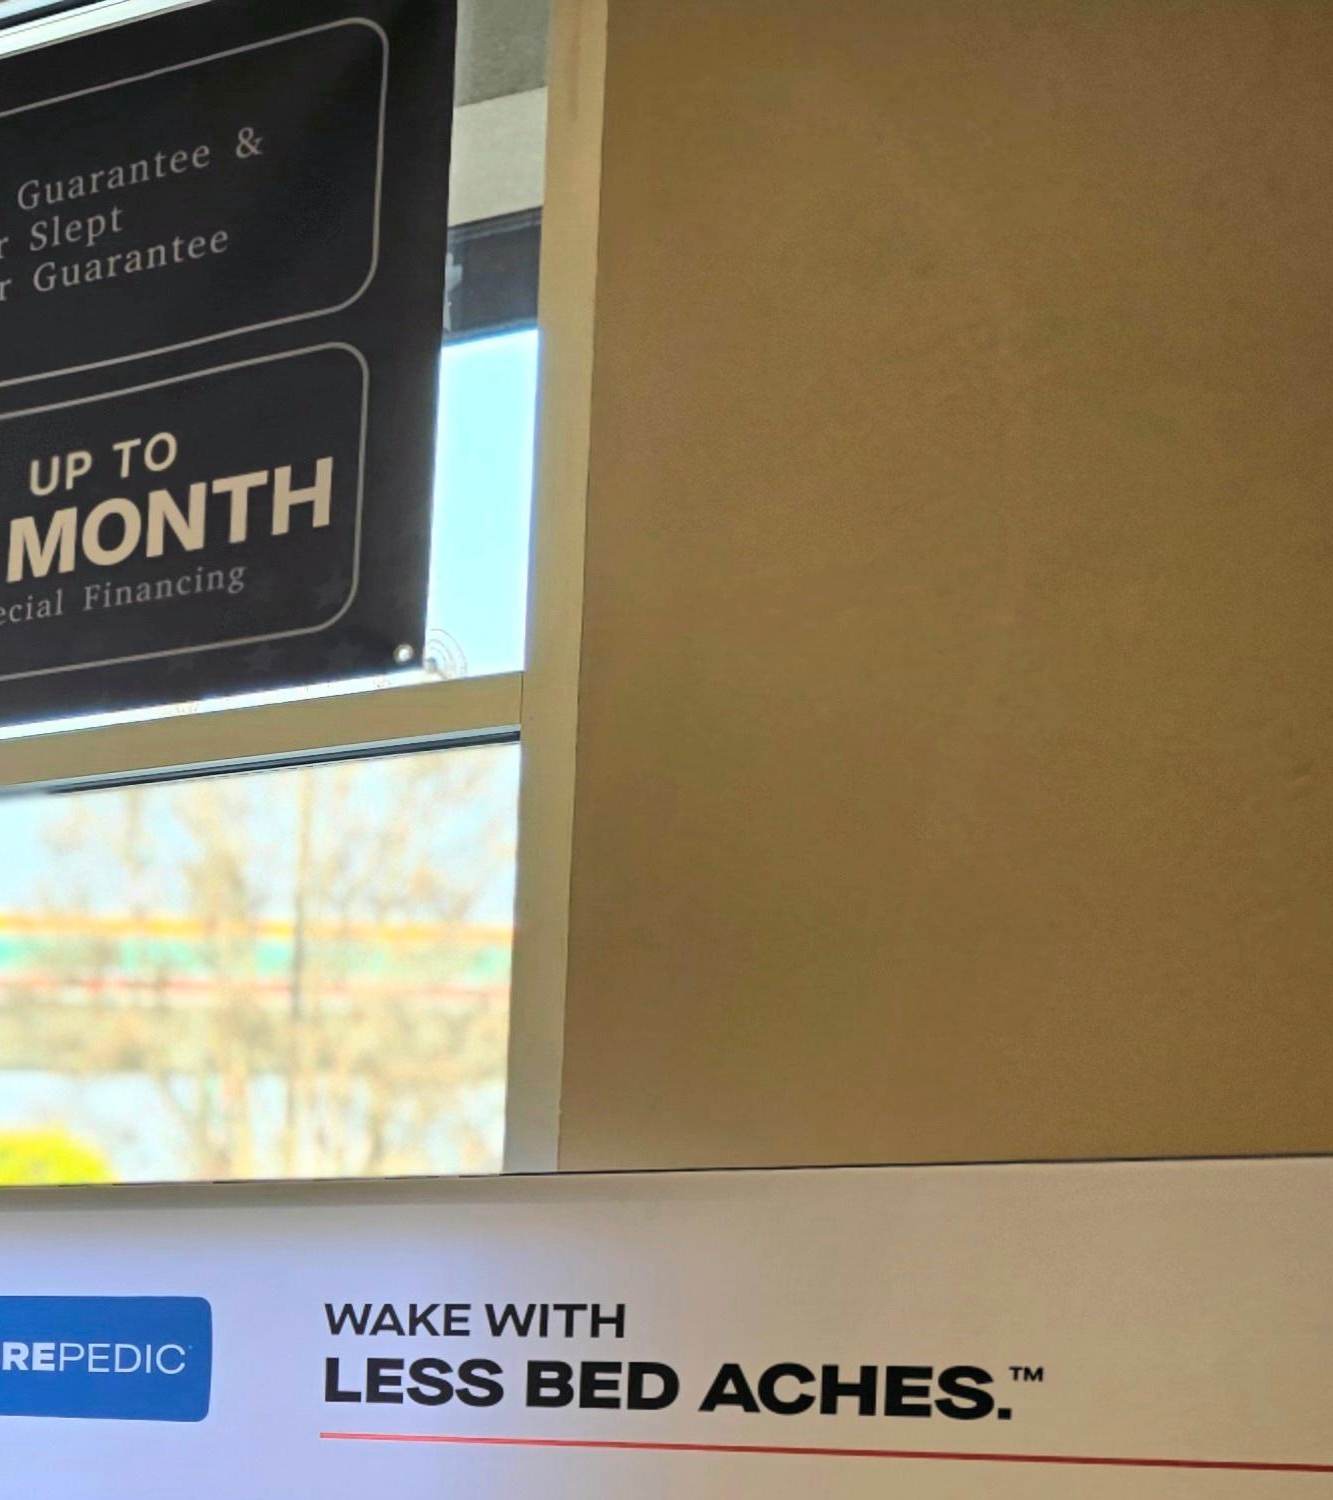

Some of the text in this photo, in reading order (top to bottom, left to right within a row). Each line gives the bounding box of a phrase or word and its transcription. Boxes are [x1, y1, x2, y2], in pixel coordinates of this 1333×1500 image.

[17, 144, 211, 210] Guarantee
[235, 126, 264, 160] &
[29, 206, 124, 252] Slept
[32, 229, 230, 292] Guarantee
[29, 431, 178, 497] UP TO
[7, 456, 334, 583] MONTH
[82, 565, 248, 612] Financing
[324, 1303, 626, 1339] WAKE WITH
[324, 1357, 504, 1408] LESS
[525, 1359, 681, 1411] BED
